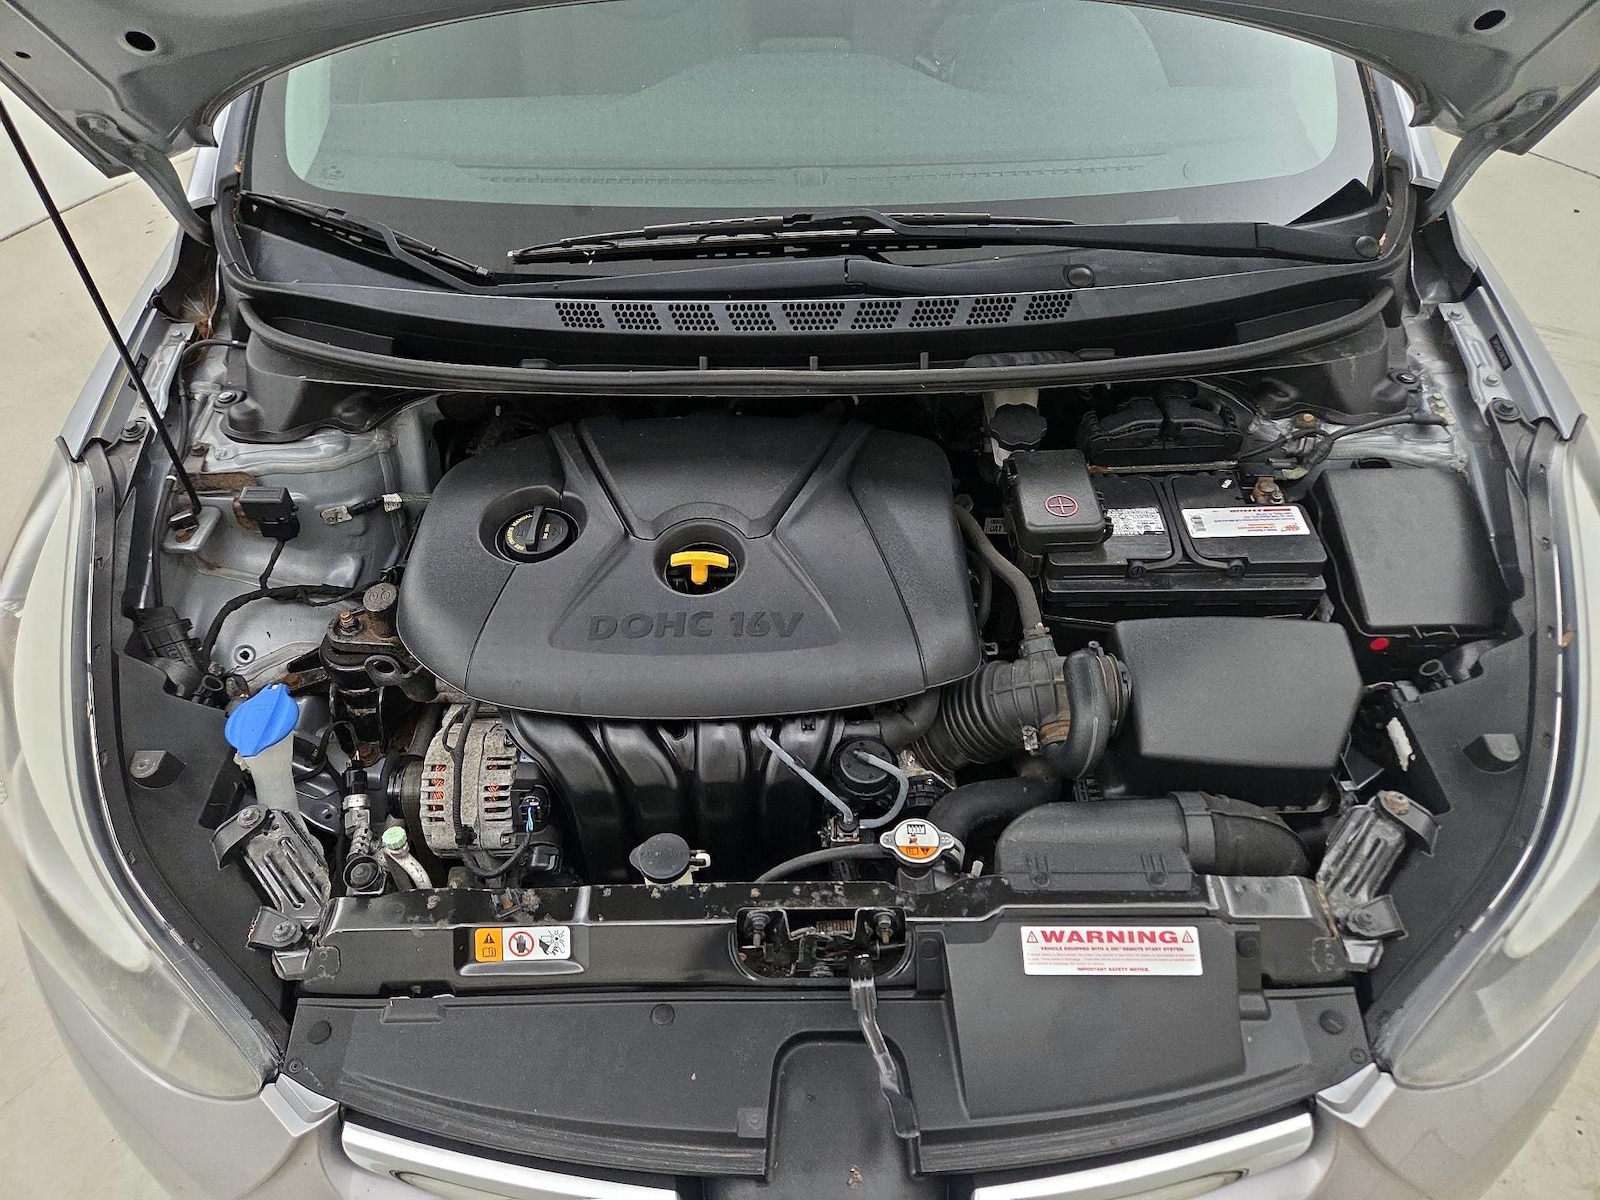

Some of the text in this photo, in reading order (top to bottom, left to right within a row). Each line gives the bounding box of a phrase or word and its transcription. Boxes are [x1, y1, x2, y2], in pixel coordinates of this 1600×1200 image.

[587, 611, 804, 641] DOHC 16V
[1040, 930, 1179, 944] WARNING
